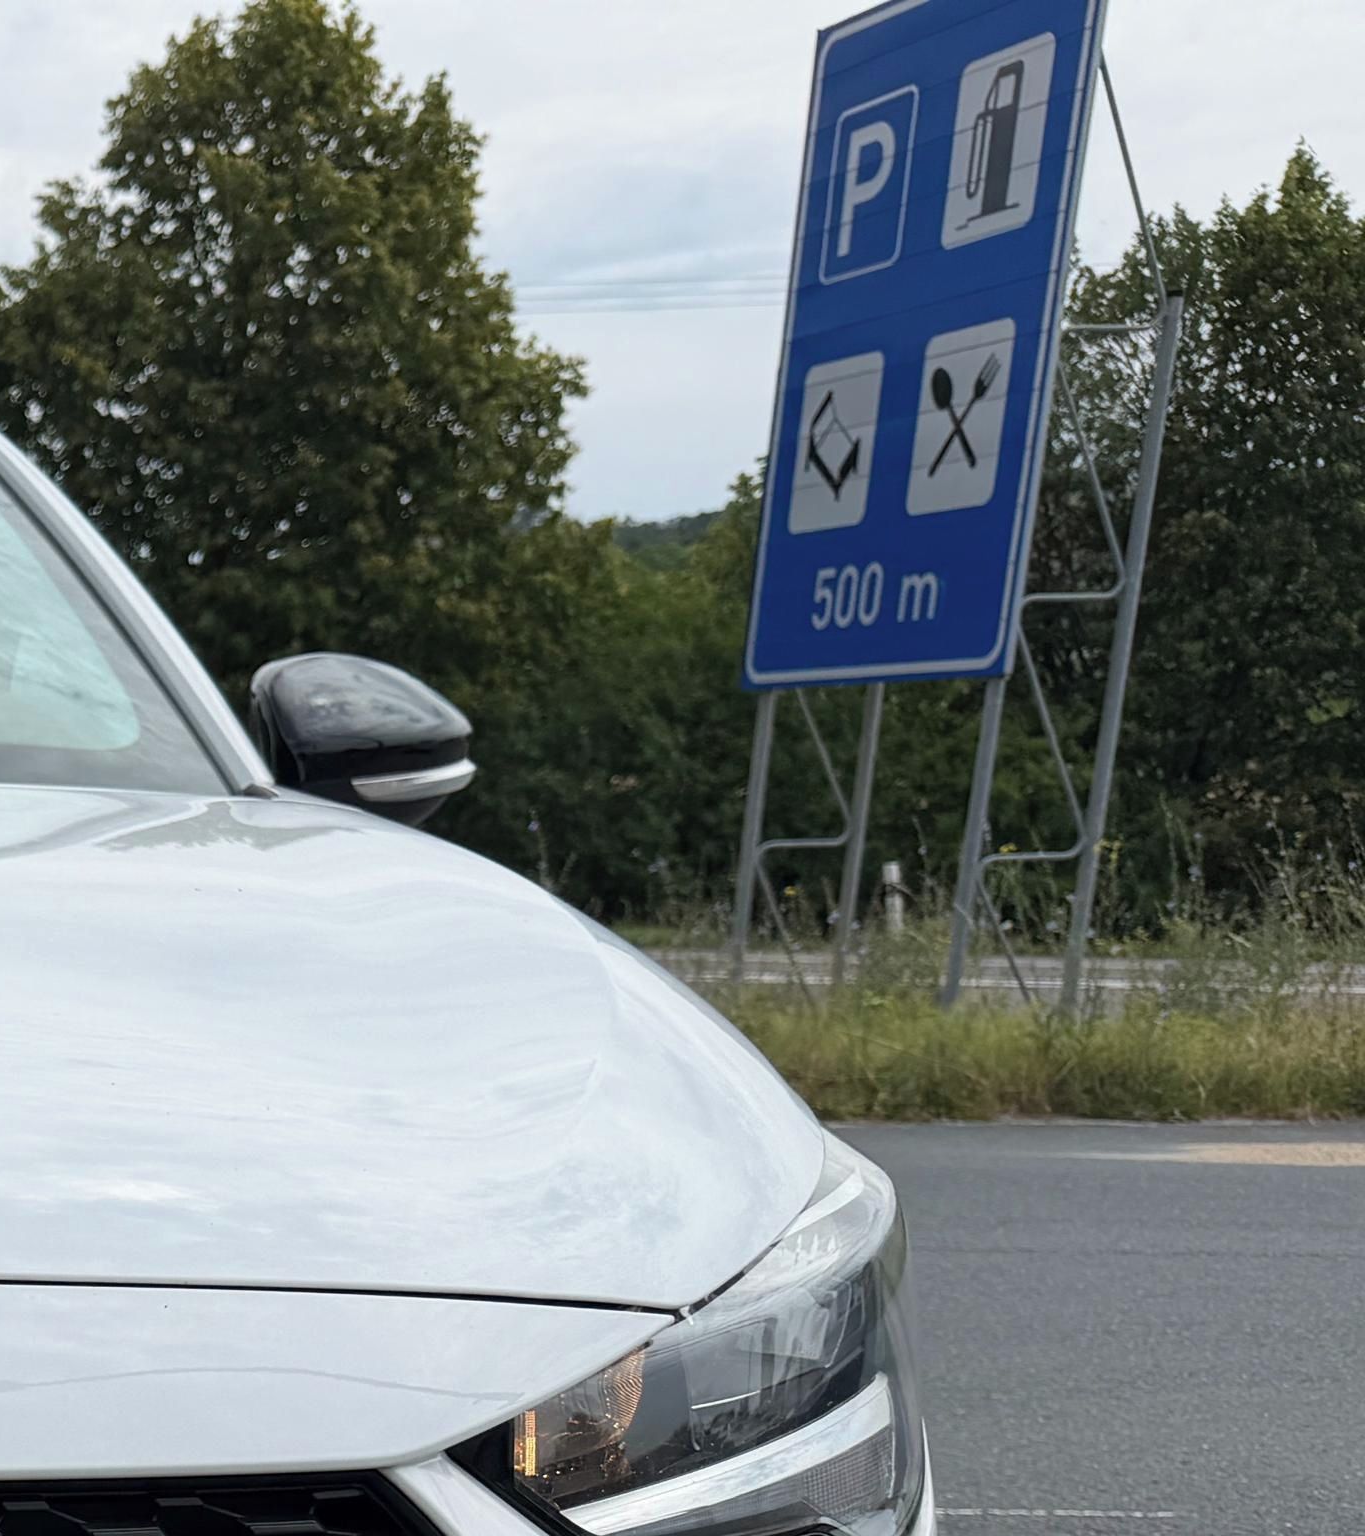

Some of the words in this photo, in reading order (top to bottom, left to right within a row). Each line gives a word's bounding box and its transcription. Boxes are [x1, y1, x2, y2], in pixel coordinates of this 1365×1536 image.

[835, 120, 896, 258] P
[810, 561, 884, 631] 500
[897, 572, 940, 622] m
